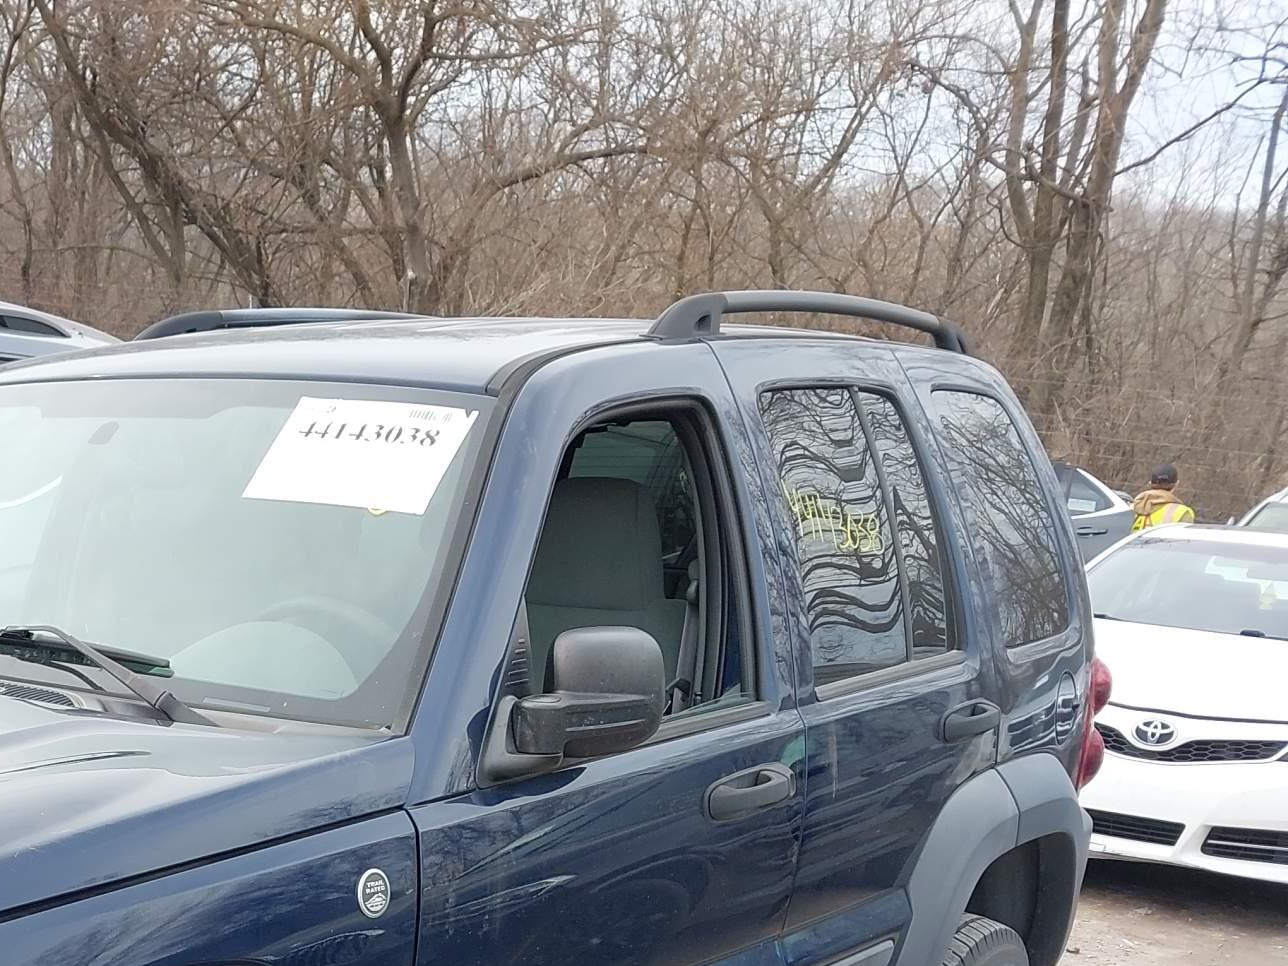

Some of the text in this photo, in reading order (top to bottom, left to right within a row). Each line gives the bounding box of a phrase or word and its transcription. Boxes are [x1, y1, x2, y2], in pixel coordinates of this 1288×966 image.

[298, 421, 441, 448] 44143038
[366, 879, 385, 888] TRAIL
[365, 885, 386, 895] RATED
